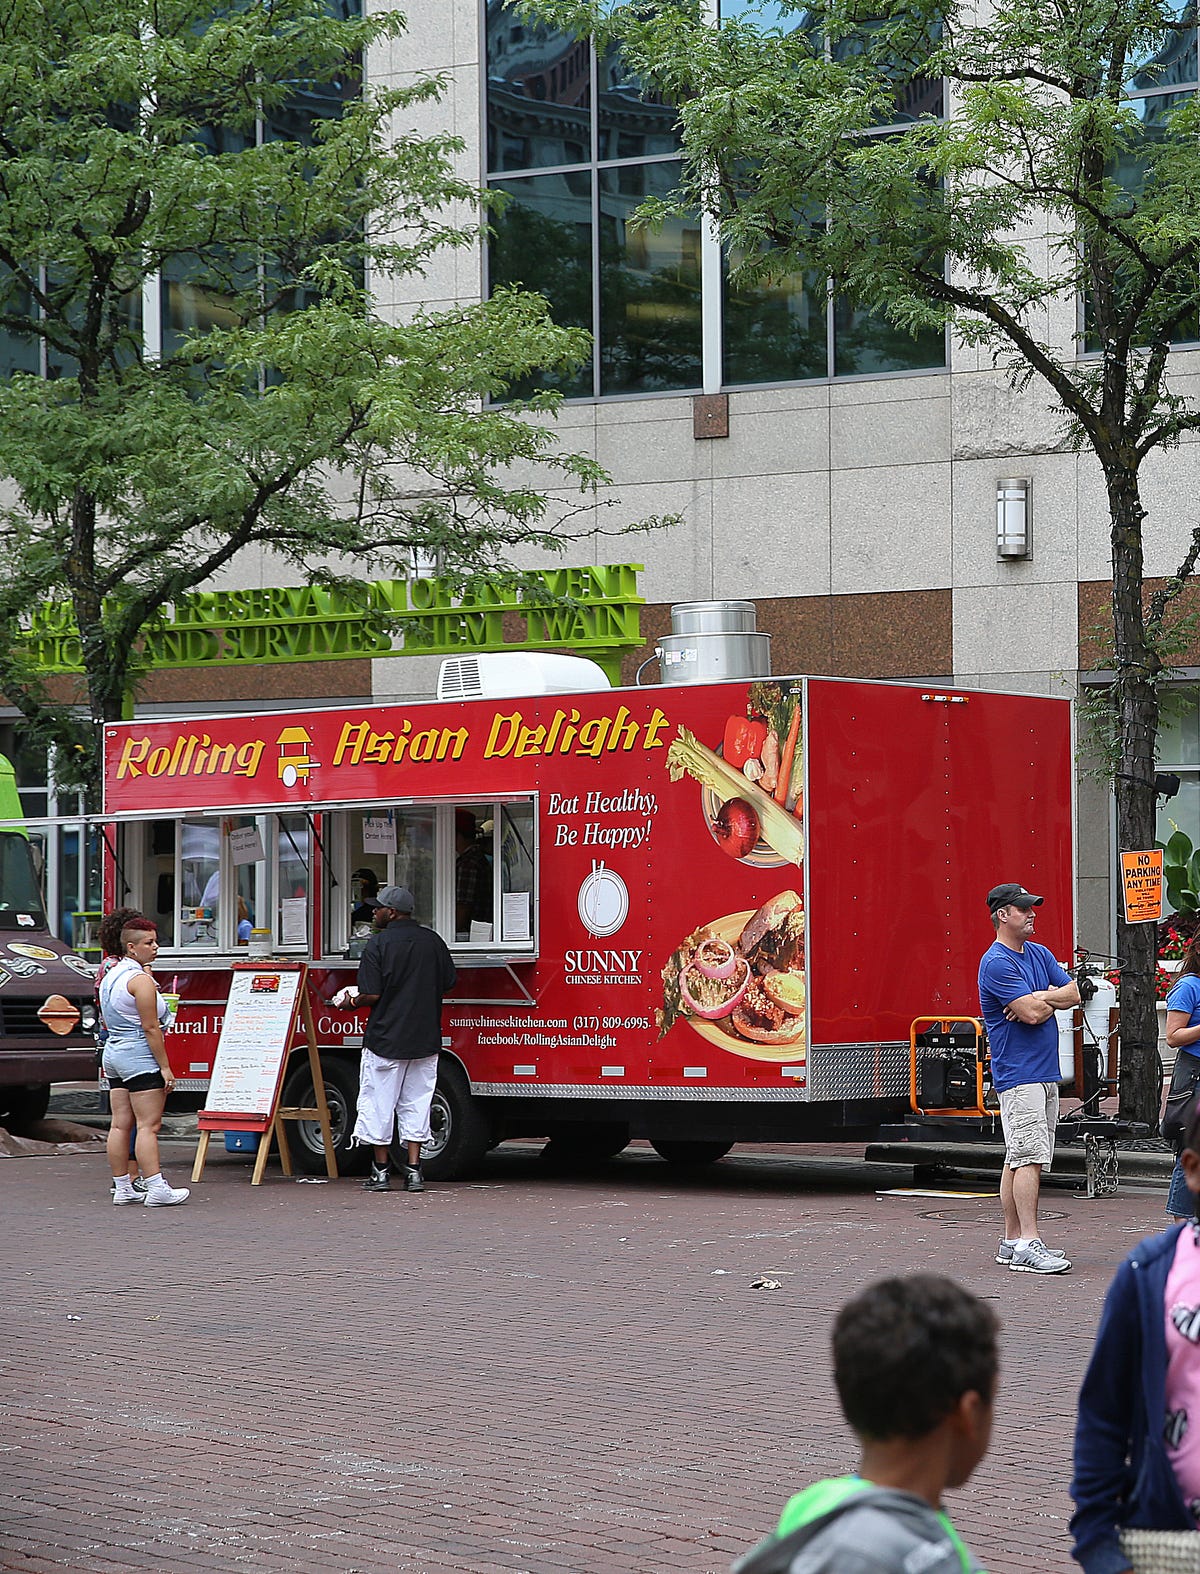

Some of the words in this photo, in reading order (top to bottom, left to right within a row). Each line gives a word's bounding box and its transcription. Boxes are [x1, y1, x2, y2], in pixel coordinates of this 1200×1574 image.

[143, 629, 220, 662] AND
[222, 617, 392, 661] SURVIVES
[518, 602, 643, 644] TWAIN
[116, 734, 265, 779] Rolling
[333, 720, 469, 766] Asian
[484, 706, 670, 759] Delight
[547, 793, 579, 815] Eat
[584, 788, 658, 816] Healthy,
[554, 824, 578, 847] Be
[582, 819, 652, 849] Happy!
[1137, 855, 1150, 865] NO
[1126, 866, 1160, 878] PARKING
[1127, 880, 1143, 889] ANY
[1145, 878, 1160, 887] TIME
[564, 950, 643, 973] SUNNY
[565, 975, 601, 985] CHINESE
[604, 975, 642, 985] KITCHEN
[167, 1015, 208, 1034] tural
[450, 1015, 567, 1030] sunnychinesekitchen.com
[573, 1016, 600, 1031] (317)
[602, 1016, 649, 1030] 809-6995
[478, 1032, 617, 1049] facebook/RollingAsianDelight
